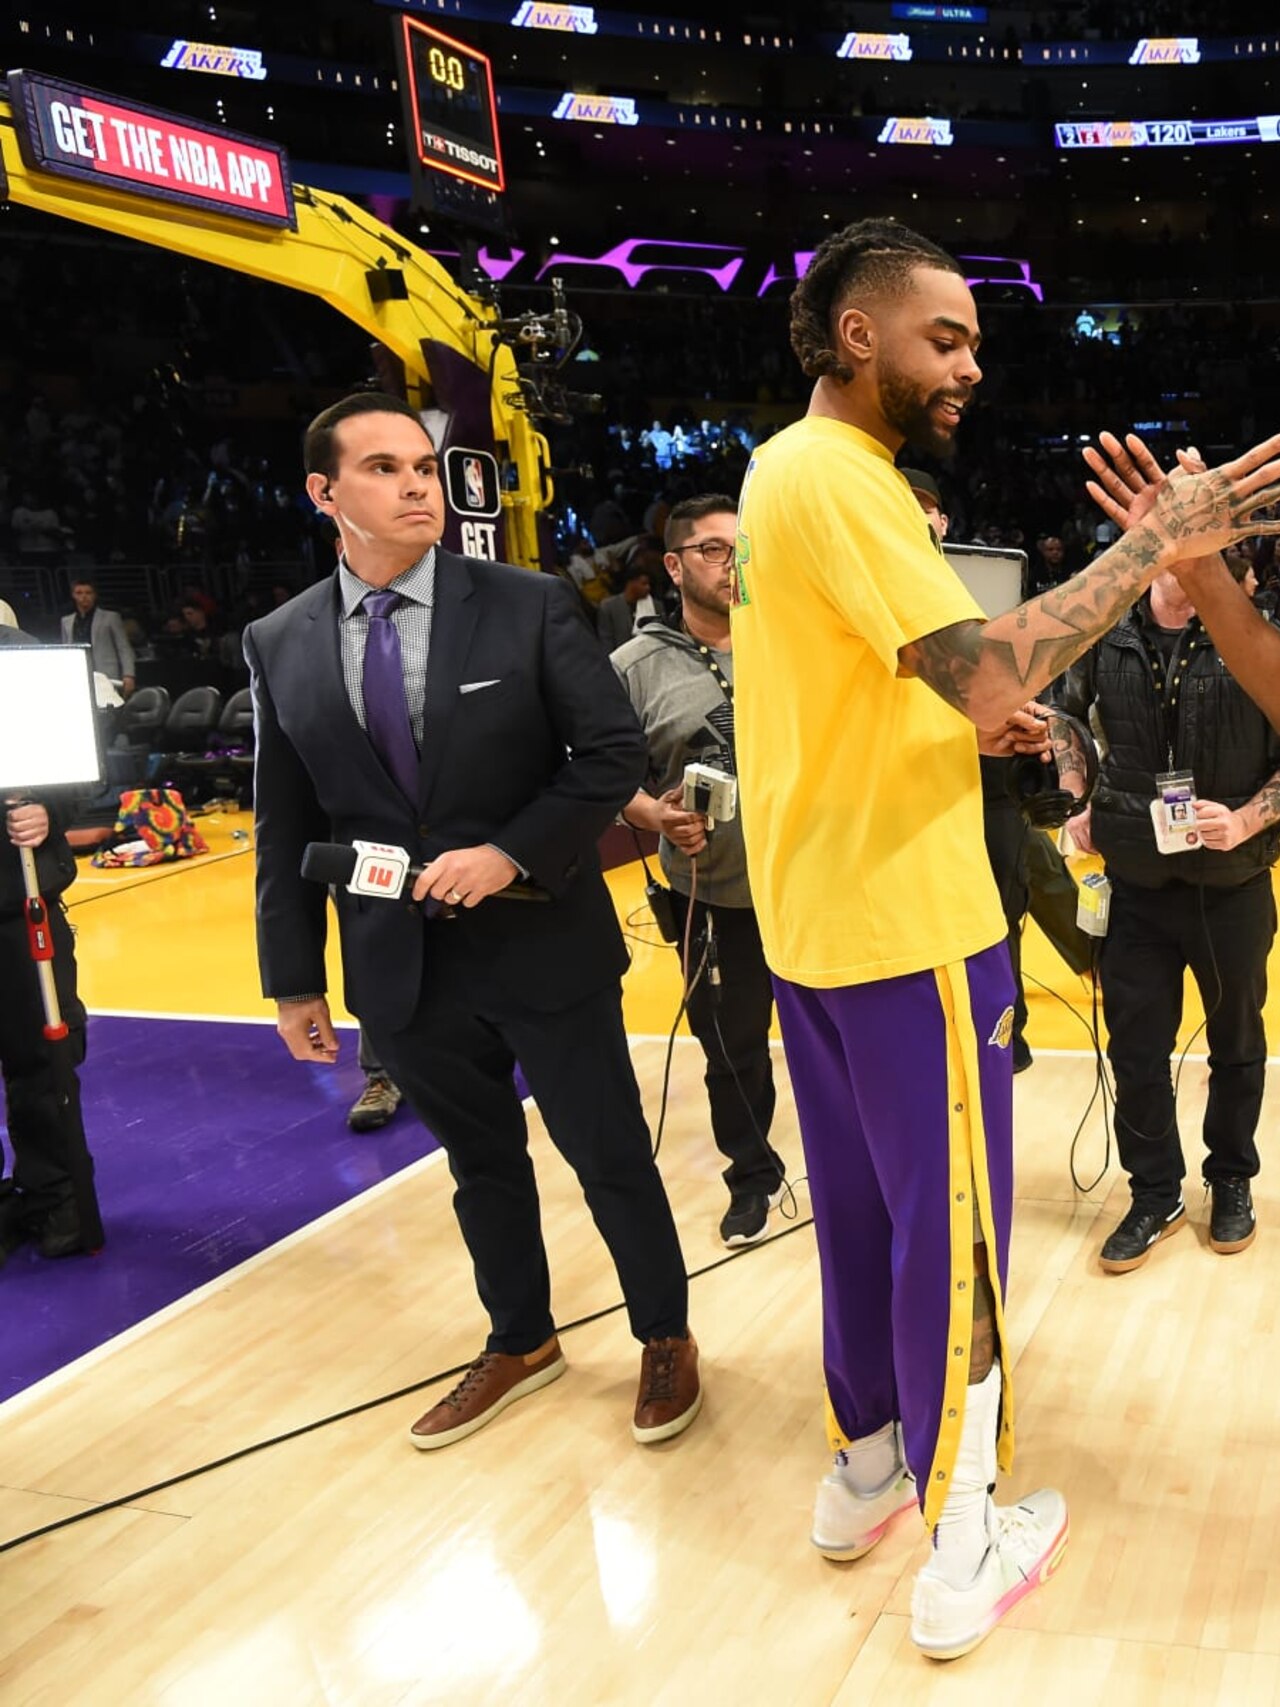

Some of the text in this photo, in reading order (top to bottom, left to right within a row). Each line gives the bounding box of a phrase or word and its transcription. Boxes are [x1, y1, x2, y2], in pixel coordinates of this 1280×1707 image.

[1151, 124, 1186, 143] 120
[1206, 126, 1247, 139] Lakers
[51, 100, 272, 204] GET THE NBA APP
[445, 141, 499, 174] TISSOT
[460, 521, 496, 561] GET
